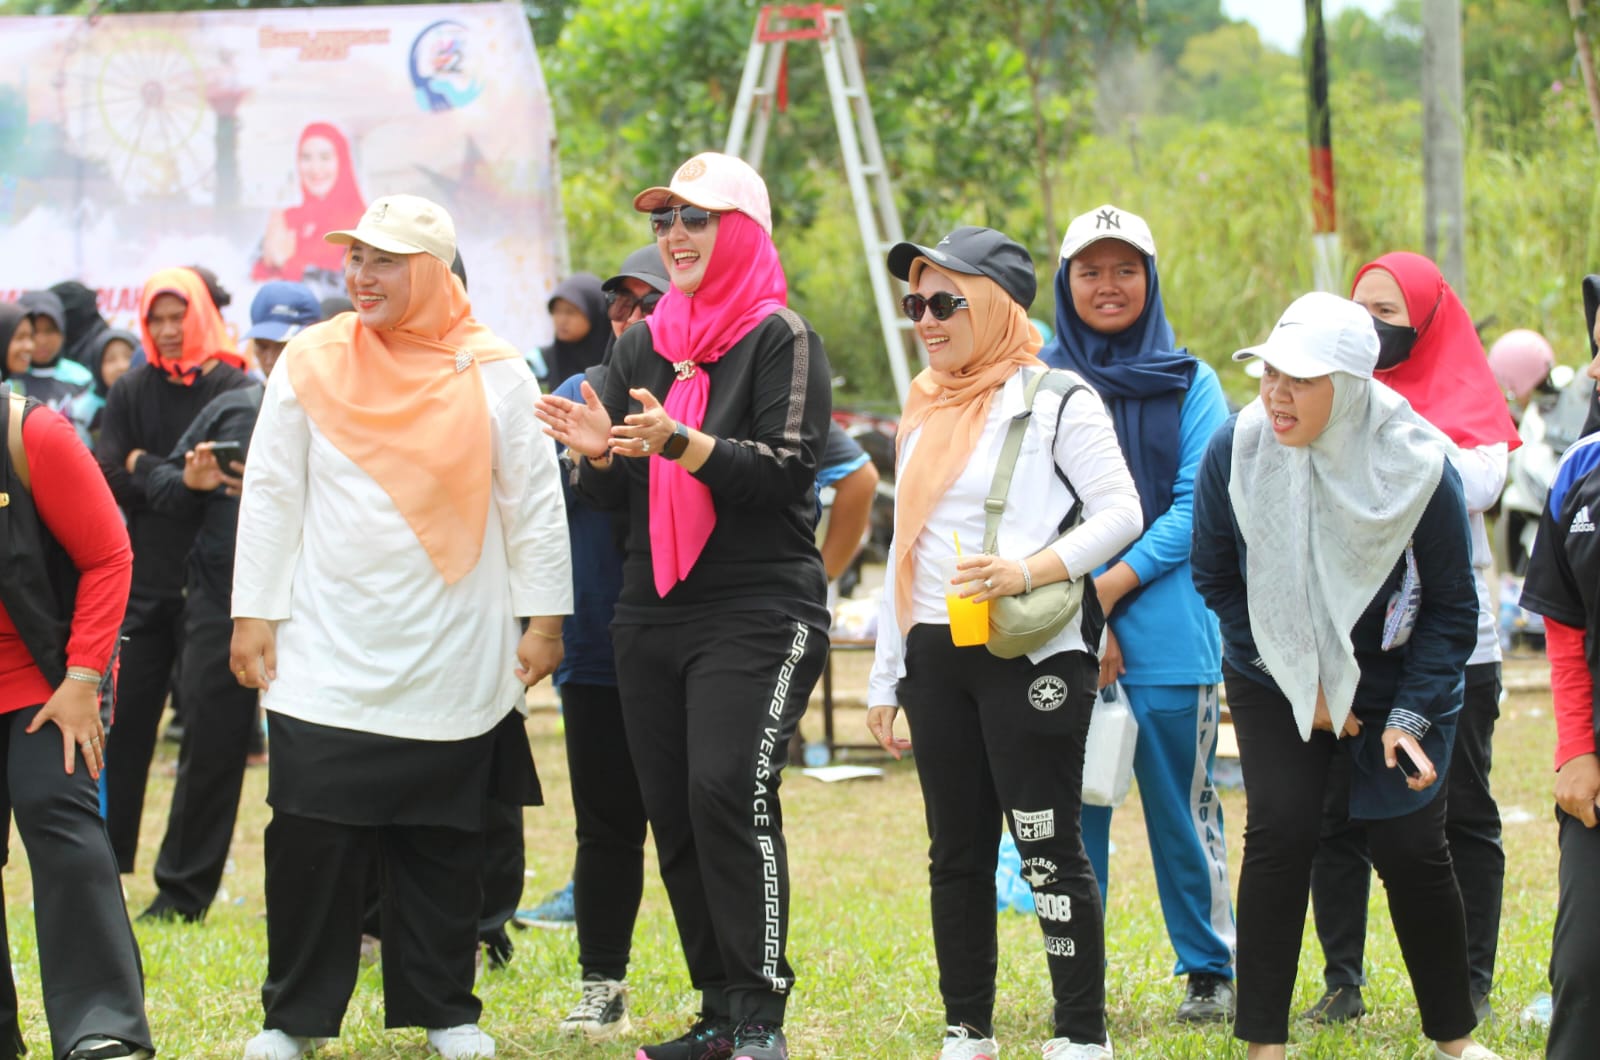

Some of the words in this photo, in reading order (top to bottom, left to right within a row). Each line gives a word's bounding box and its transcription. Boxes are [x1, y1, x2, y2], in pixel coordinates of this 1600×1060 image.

[1096, 210, 1120, 229] NY
[753, 727, 779, 827] VERSACE
[1033, 821, 1052, 838] STAR
